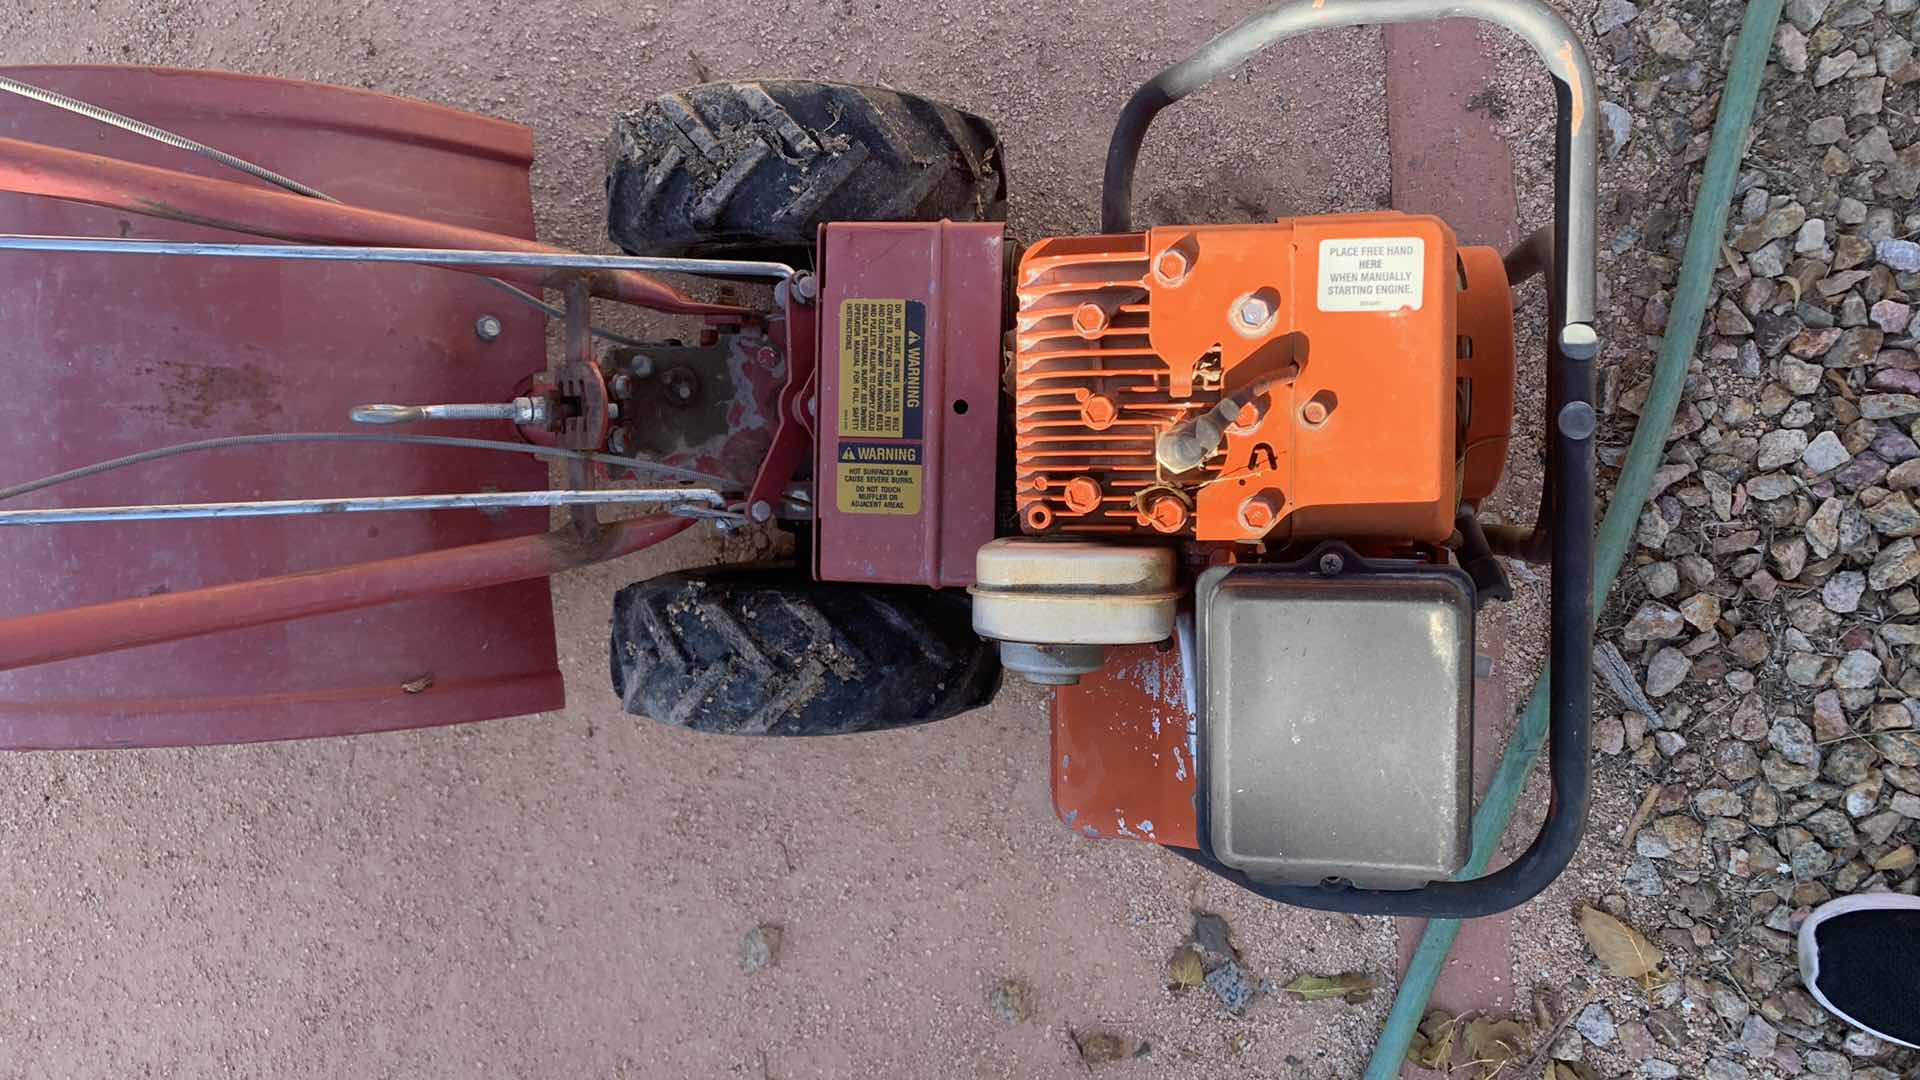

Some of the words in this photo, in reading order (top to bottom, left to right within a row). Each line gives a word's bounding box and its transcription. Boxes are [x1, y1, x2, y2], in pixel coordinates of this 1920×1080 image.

[1329, 247, 1358, 257] PLACE
[1361, 246, 1384, 256] FREE
[1387, 246, 1413, 256] HAND
[1359, 259, 1382, 269] HERE
[1329, 272, 1358, 282] WHEN
[1360, 271, 1412, 282] MANUALLY
[1328, 285, 1373, 296] STARTING
[1375, 284, 1413, 295] ENGINE.
[895, 304, 901, 313] DO
[853, 304, 861, 336] OPERATOR
[877, 319, 885, 349] CLOTHING
[861, 336, 869, 367] PERSONAL
[852, 371, 860, 384] FOR
[907, 347, 921, 408] WARNING
[868, 385, 876, 409] COMPLY
[876, 388, 884, 412] MOVING
[858, 447, 916, 461] WARNING
[863, 468, 894, 476] SURFACES
